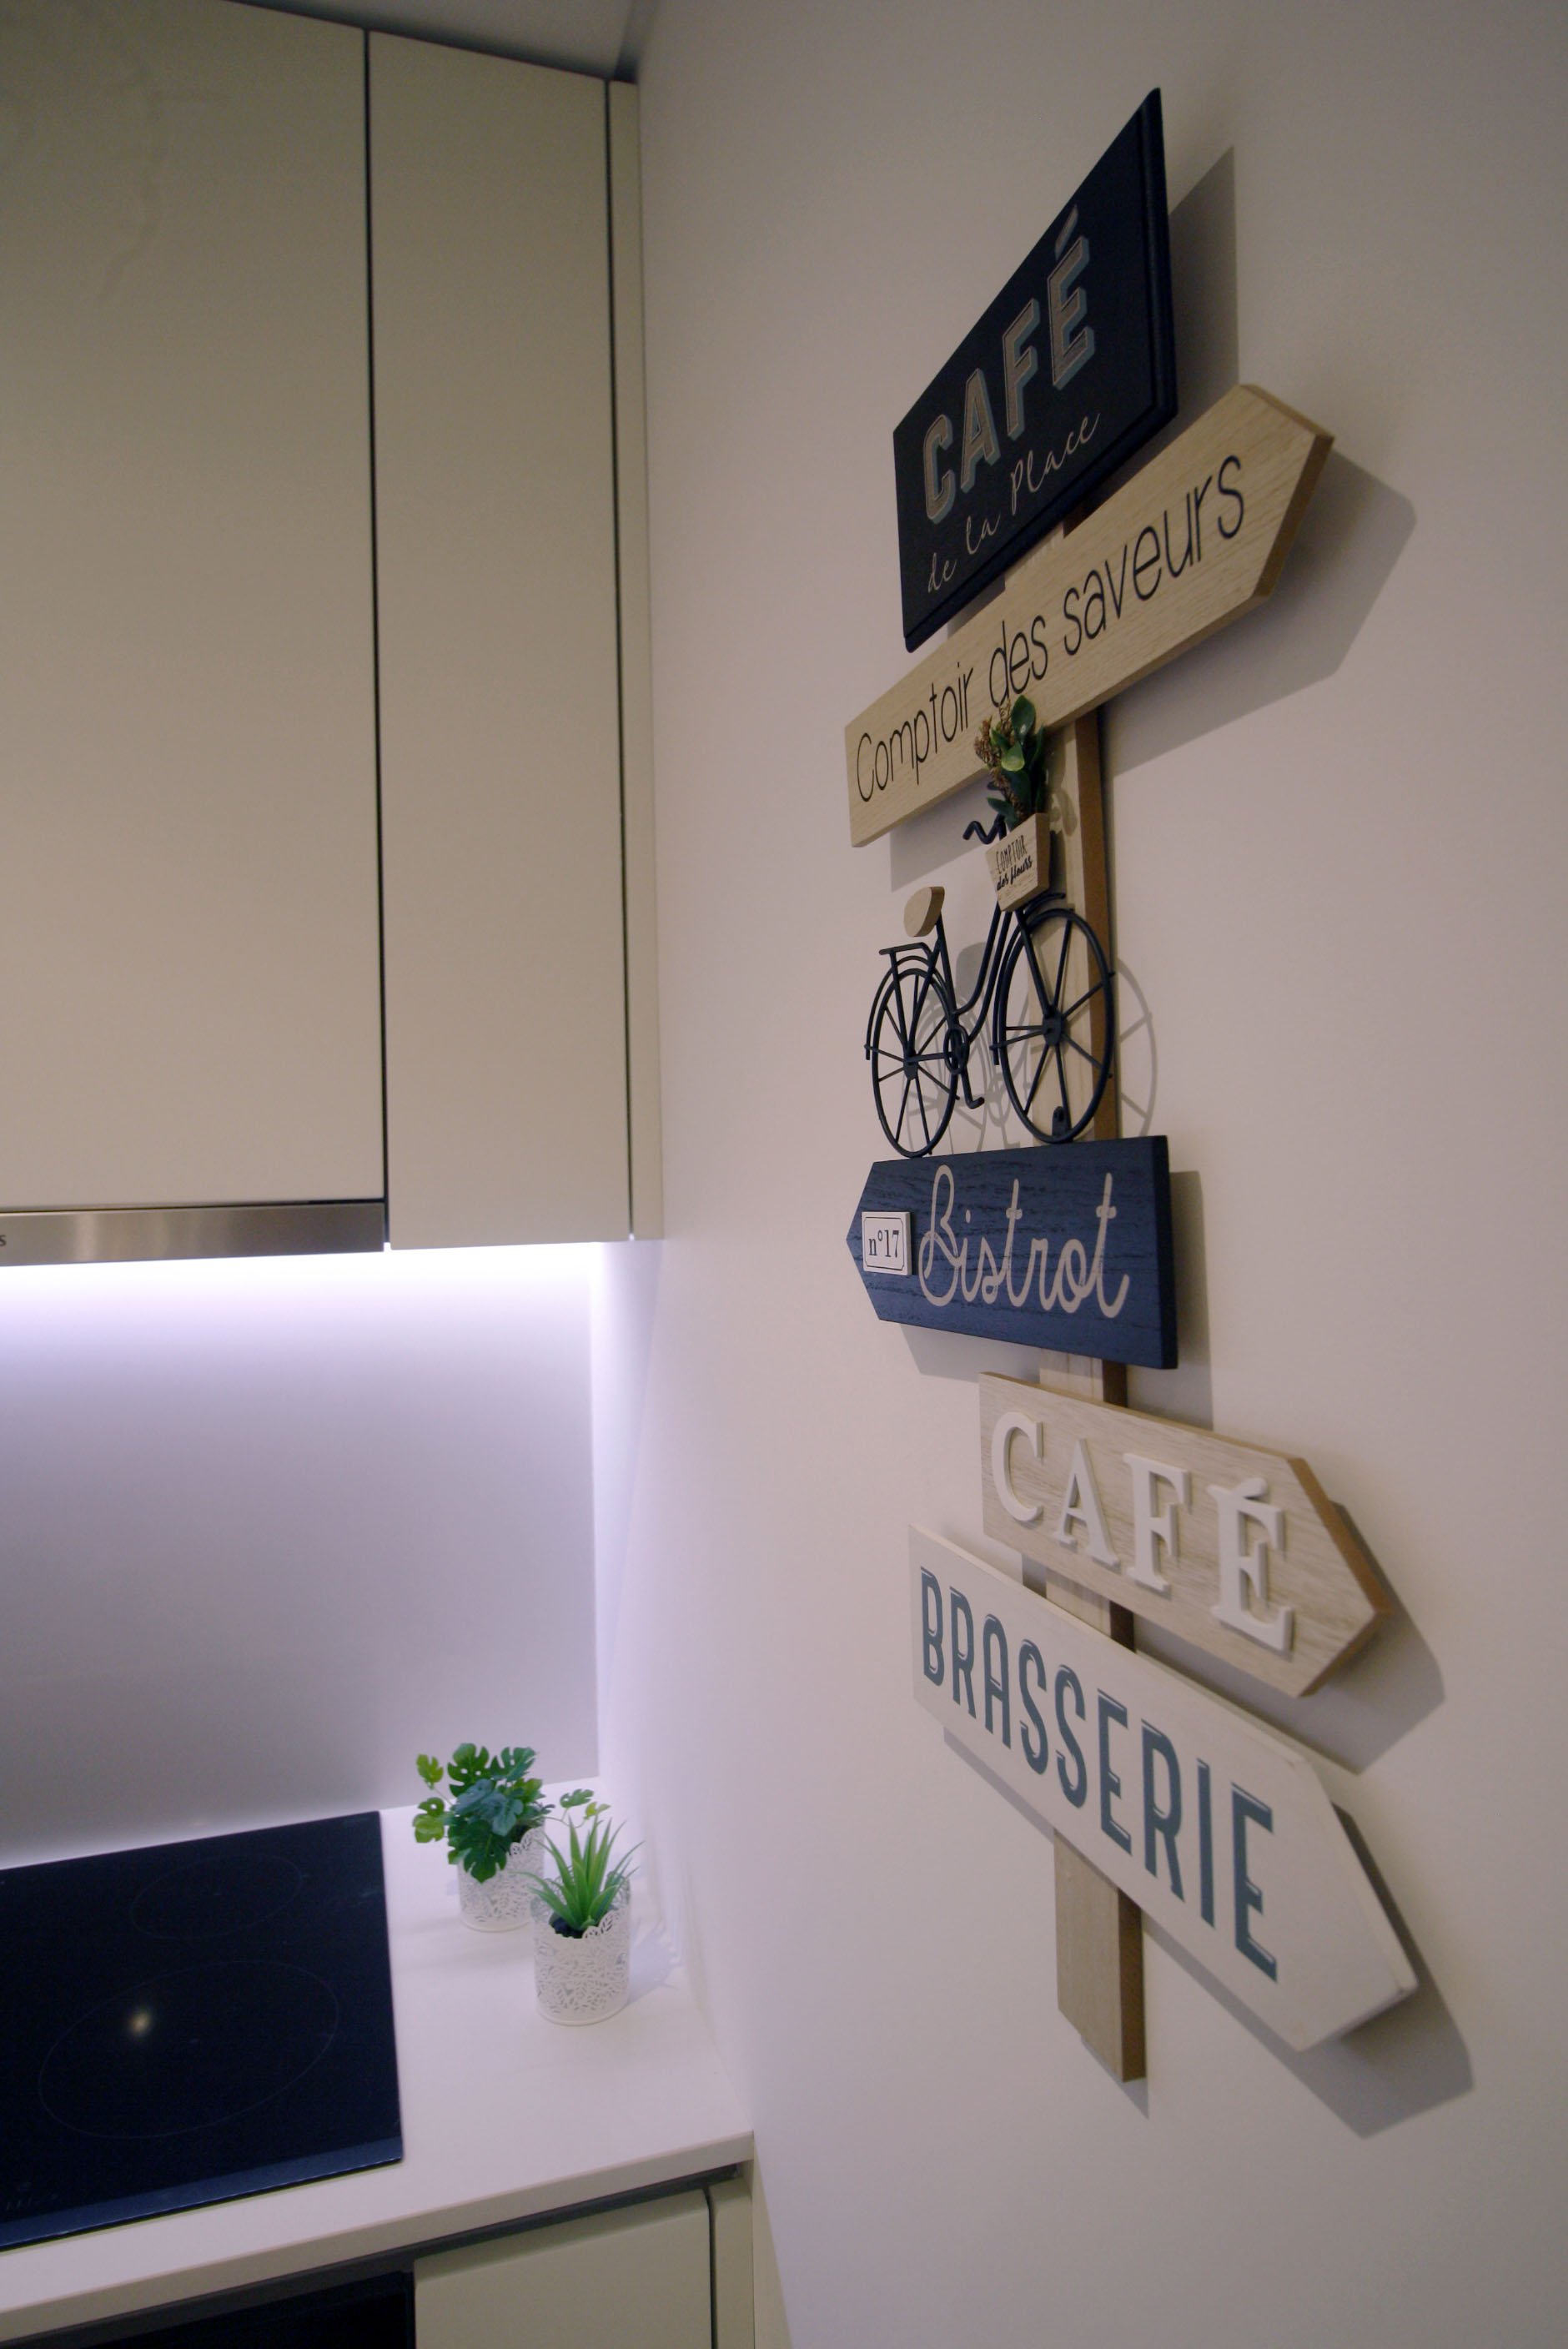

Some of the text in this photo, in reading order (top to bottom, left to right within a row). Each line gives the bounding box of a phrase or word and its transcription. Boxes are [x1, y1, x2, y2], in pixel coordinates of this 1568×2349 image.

[922, 204, 1095, 525] CAFÉ
[857, 455, 1245, 802] Comptoir des saveurs
[927, 552, 957, 593] de
[965, 512, 1001, 556] la
[918, 1164, 1129, 1319] Bistrot
[990, 1411, 1293, 1652] CAFÉ
[920, 1566, 1278, 1983] BRASSERIE
